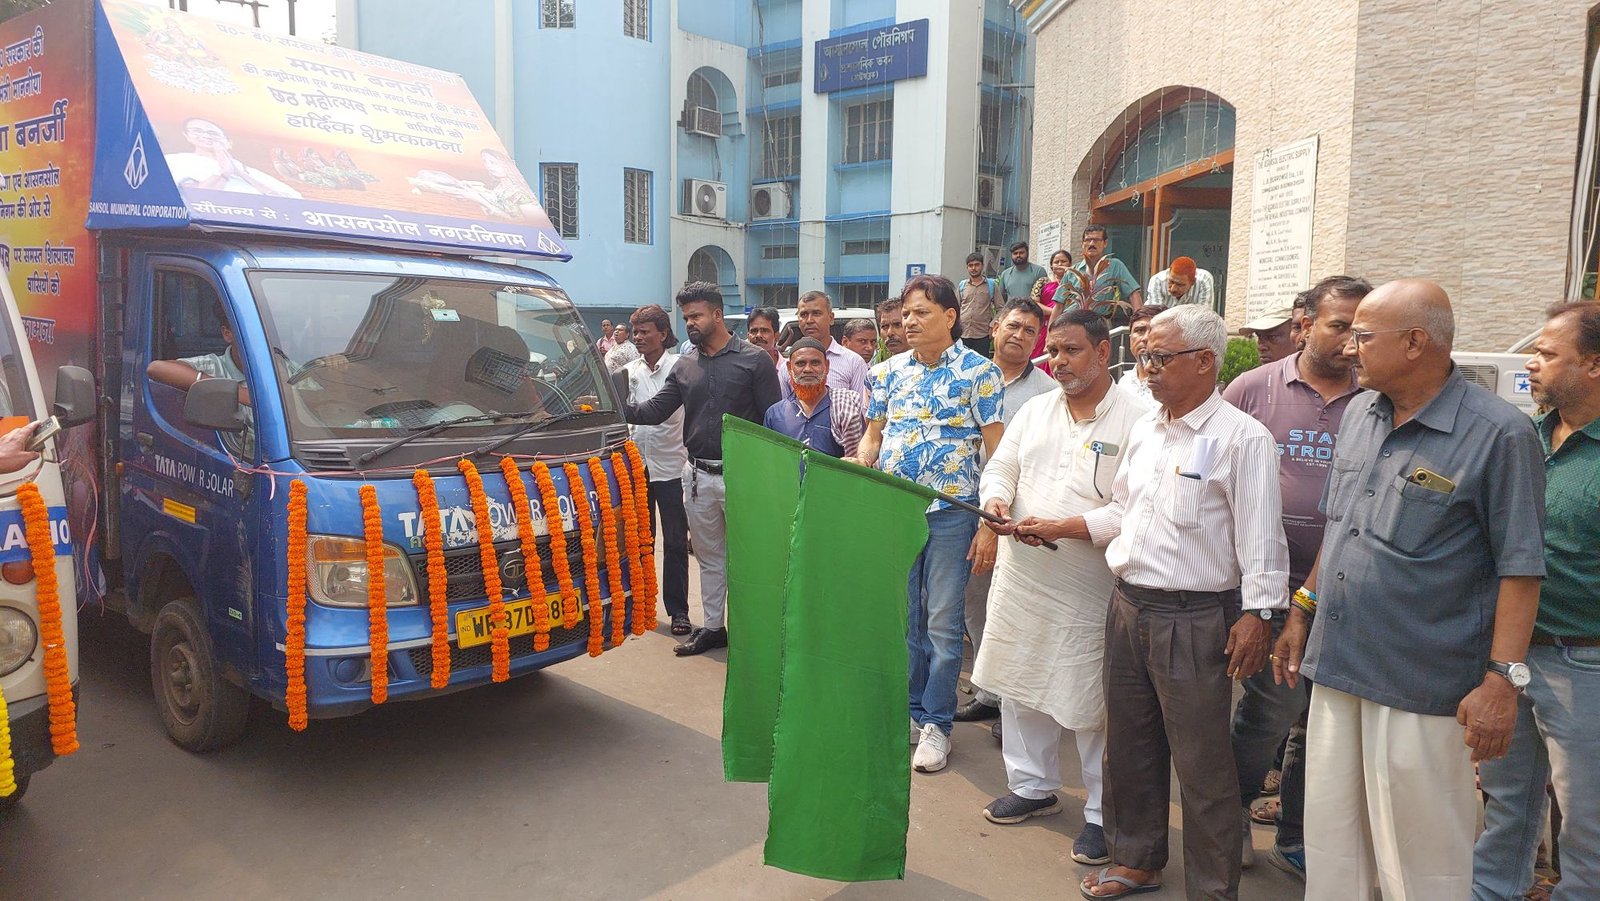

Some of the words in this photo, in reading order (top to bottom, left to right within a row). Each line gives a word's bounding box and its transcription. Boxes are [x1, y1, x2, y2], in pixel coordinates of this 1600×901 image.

[5, 38, 31, 65] सरकार
[32, 25, 44, 57] की
[285, 56, 356, 81] ममता
[363, 73, 433, 98] बनर्जी
[267, 86, 299, 107] छठ
[301, 89, 368, 115] महोत्सव
[14, 98, 68, 147] बनर्जी
[286, 112, 355, 134] हार्दिक
[360, 124, 464, 153] शुभकामना
[24, 161, 60, 188] आसनसोल
[110, 203, 141, 216] MUNICIPAL
[142, 204, 188, 220] CORPORATION
[191, 201, 255, 217] सौजन्य
[258, 206, 277, 219] से
[301, 210, 421, 236] आसनसोल
[425, 223, 527, 248] नगरनिगम
[1276, 443, 1335, 460] STRO
[1289, 429, 1338, 445] STA
[155, 454, 176, 478] TATA
[178, 462, 205, 488] POWR
[486, 499, 543, 528] OWR
